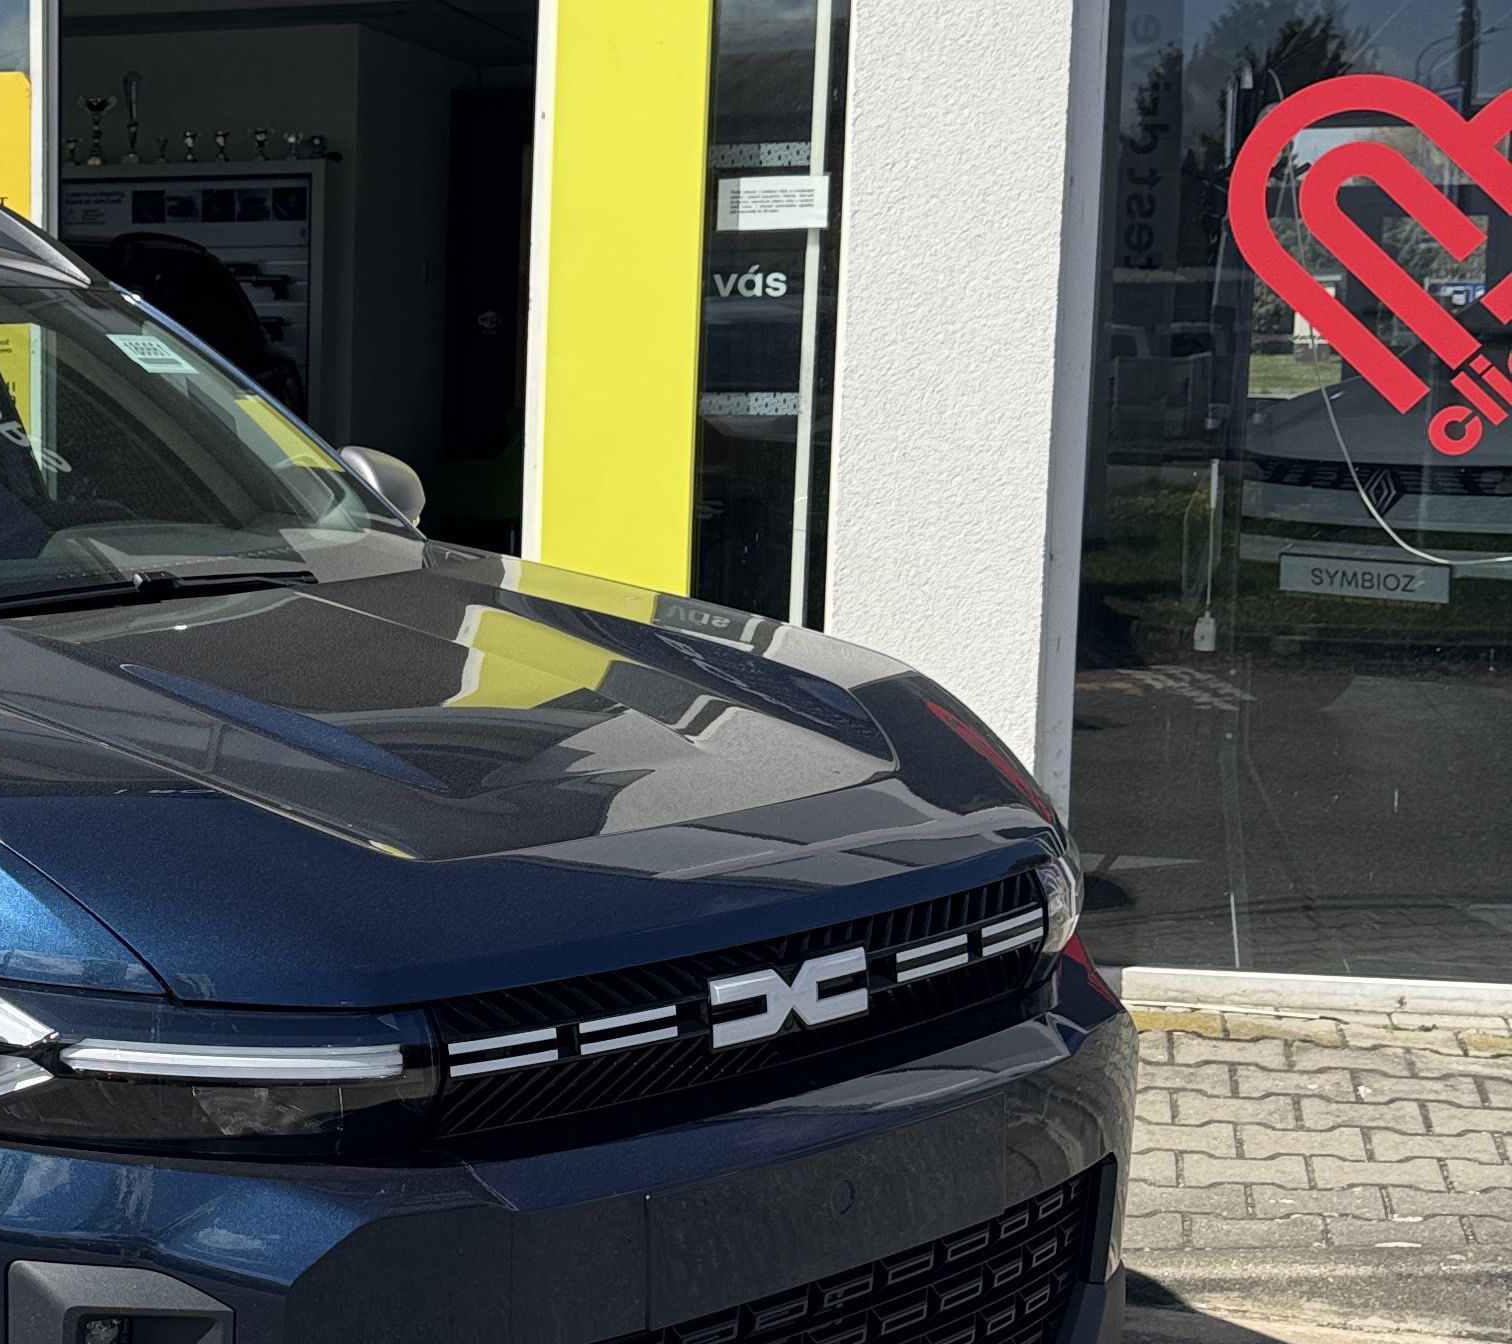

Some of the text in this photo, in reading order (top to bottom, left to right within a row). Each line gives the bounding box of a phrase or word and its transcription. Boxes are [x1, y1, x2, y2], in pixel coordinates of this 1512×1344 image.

[713, 264, 787, 297] vás
[1427, 350, 1512, 456] cli
[1311, 567, 1416, 592] SYMBIOZ
